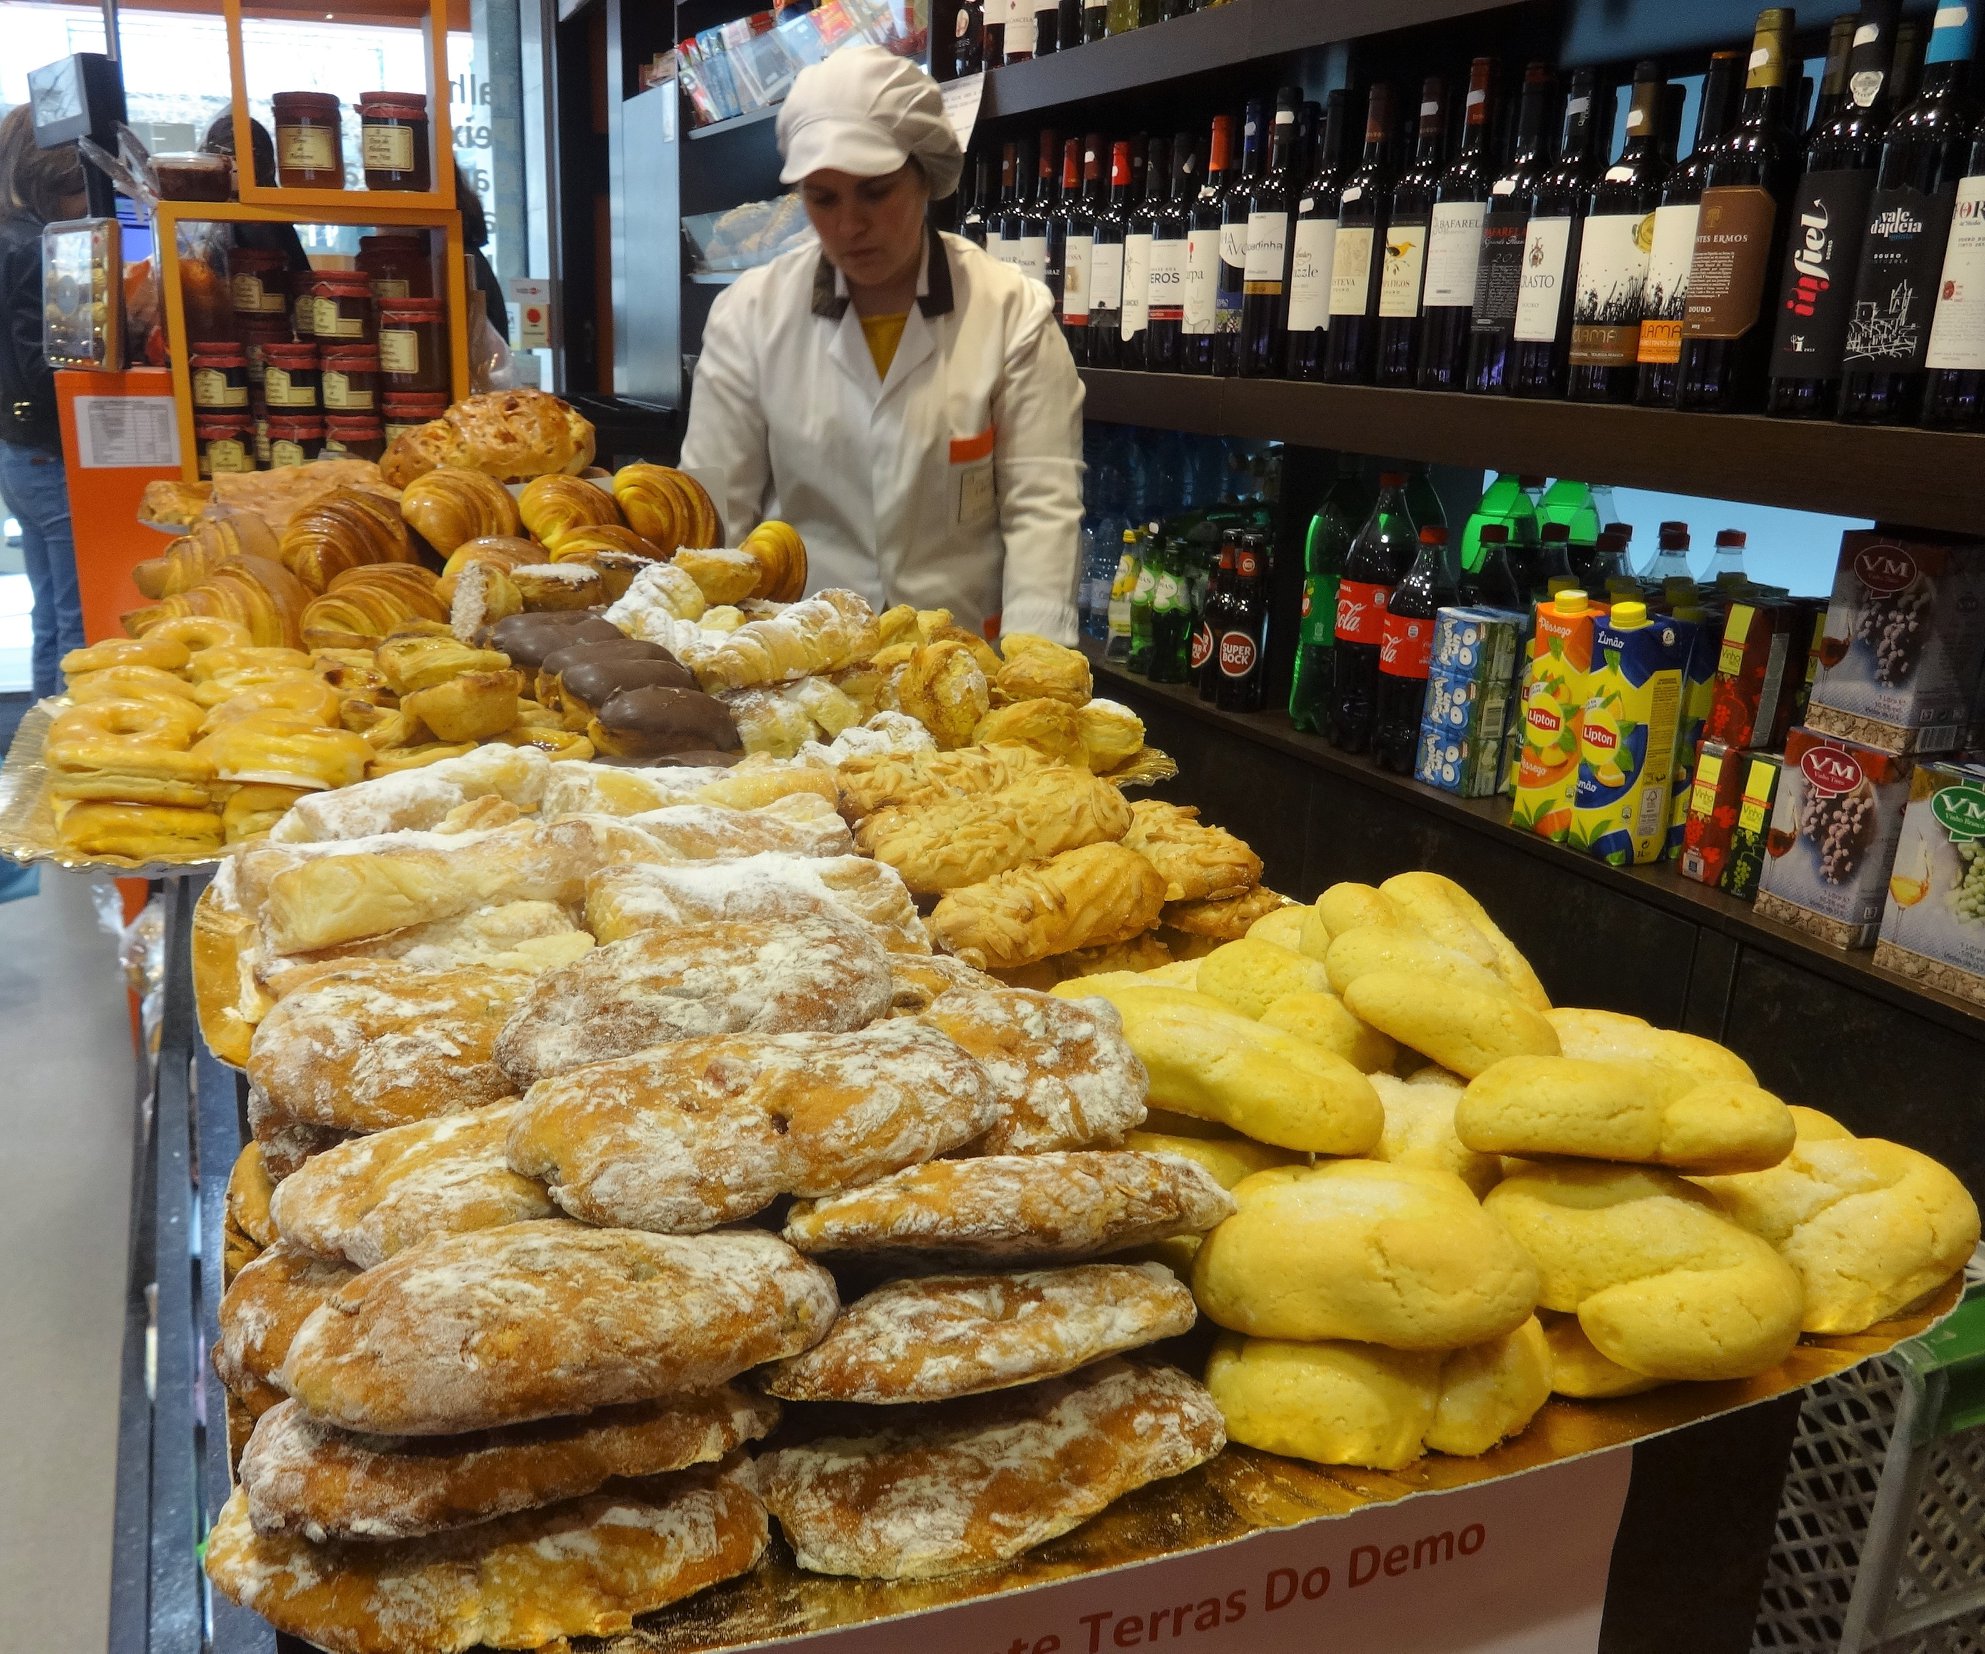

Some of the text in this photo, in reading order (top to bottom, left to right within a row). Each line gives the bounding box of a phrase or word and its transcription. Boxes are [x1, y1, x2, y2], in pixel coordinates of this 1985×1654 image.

[1881, 207, 1910, 223] vale
[1713, 234, 1748, 244] ERMOS
[1861, 555, 1910, 578] VM
[1539, 615, 1573, 638] Pêssego
[1598, 630, 1625, 649] Limão
[1222, 642, 1251, 656] SUPER
[1722, 649, 1741, 663] Vinho
[1222, 652, 1248, 665] BOCK
[1528, 709, 1556, 728] Lipton
[1583, 727, 1613, 746] Lipton
[1807, 753, 1855, 781] VM
[1695, 788, 1714, 801] Vinho
[1743, 805, 1763, 819] Vinho
[1079, 1589, 1247, 1654] Terras
[1264, 1566, 1331, 1612] Do
[1348, 1523, 1486, 1589] Demo
